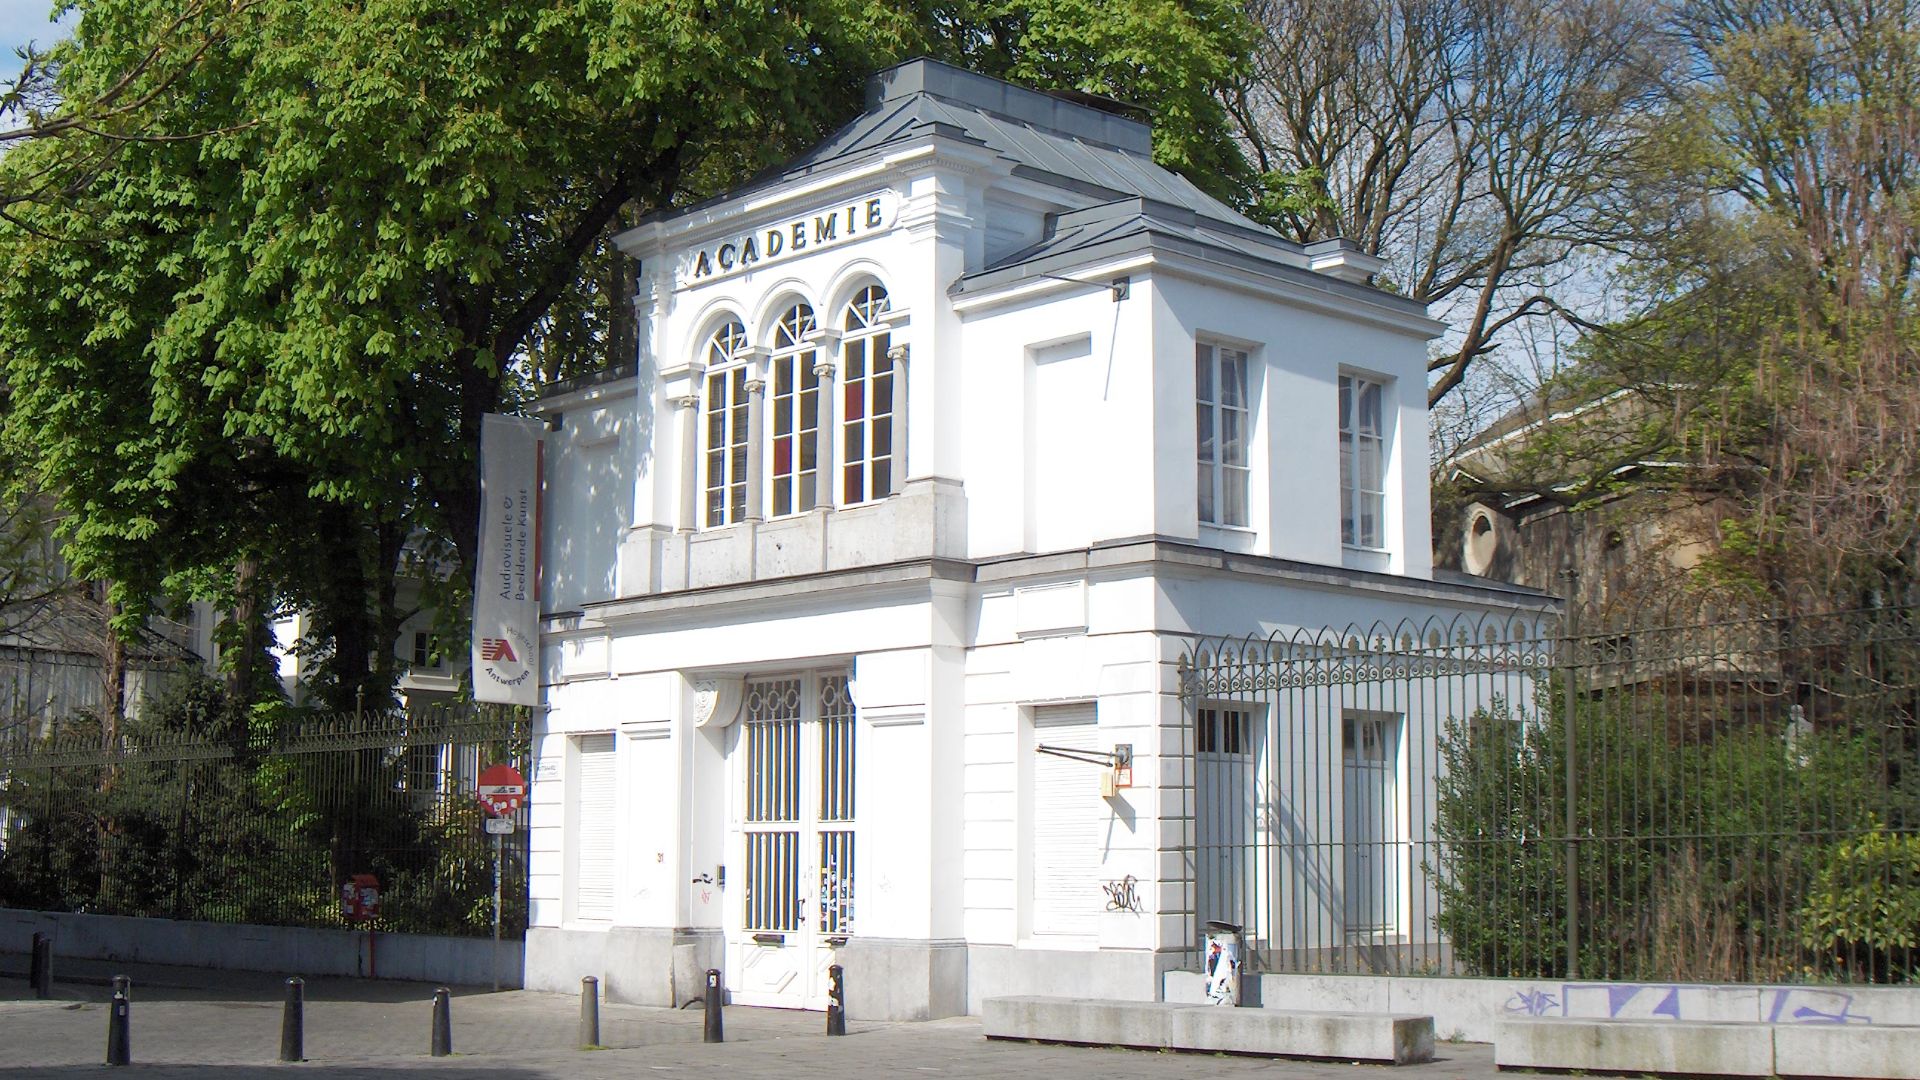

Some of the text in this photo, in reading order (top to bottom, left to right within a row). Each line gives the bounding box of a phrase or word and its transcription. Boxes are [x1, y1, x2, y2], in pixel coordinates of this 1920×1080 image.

[694, 198, 882, 279] ACADEMIE
[500, 514, 513, 601] Audiovisuele
[515, 489, 528, 601] Beeldende Kunst
[485, 667, 530, 686] Antwerpen
